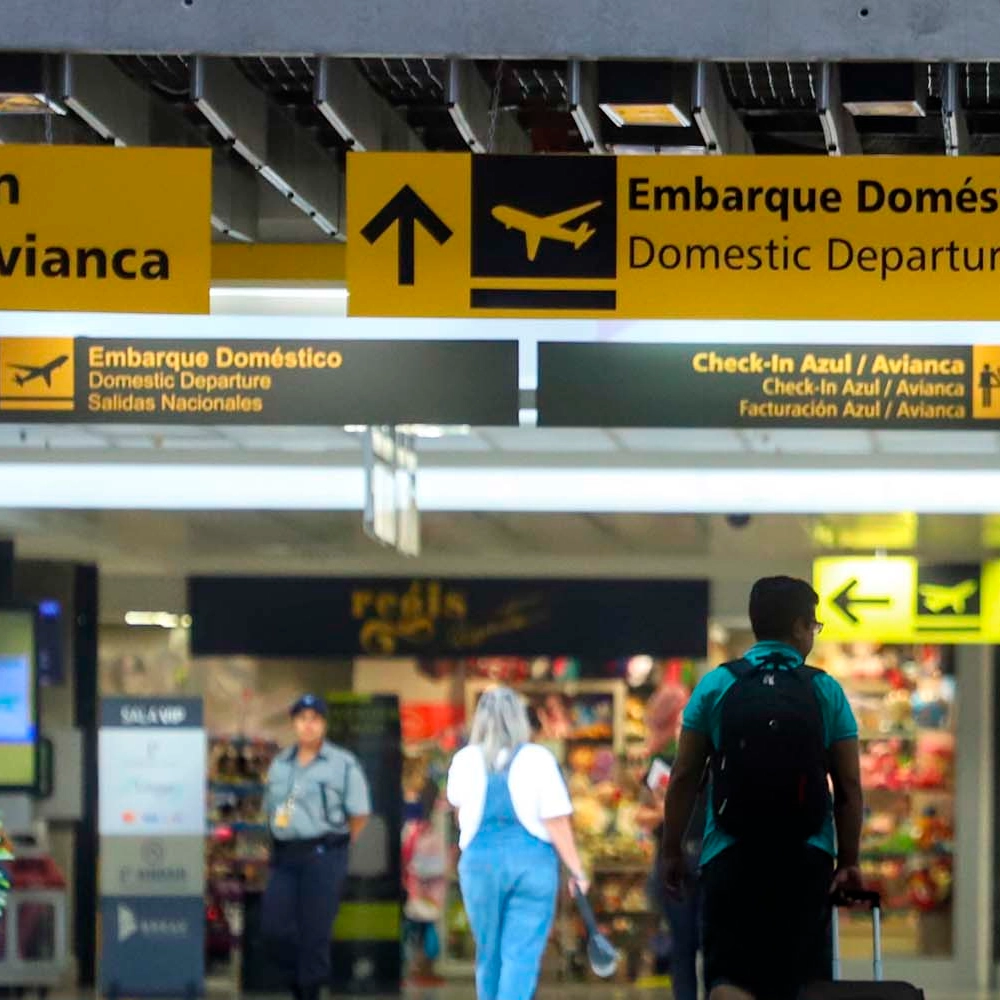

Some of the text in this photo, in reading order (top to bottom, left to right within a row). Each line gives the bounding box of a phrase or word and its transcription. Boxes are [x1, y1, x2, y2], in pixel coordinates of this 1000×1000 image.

[628, 176, 842, 221] Embarque
[629, 235, 811, 270] Domestic
[88, 345, 343, 371] Embarque Doméstico
[692, 351, 965, 376] Check-In Azul / Avianca
[89, 371, 271, 393] Domestic Departure
[762, 377, 965, 398] Check-In Azul / Avianca
[88, 393, 263, 412] Salidas Nacionales
[739, 399, 966, 419] Facturación Azul / Avianca
